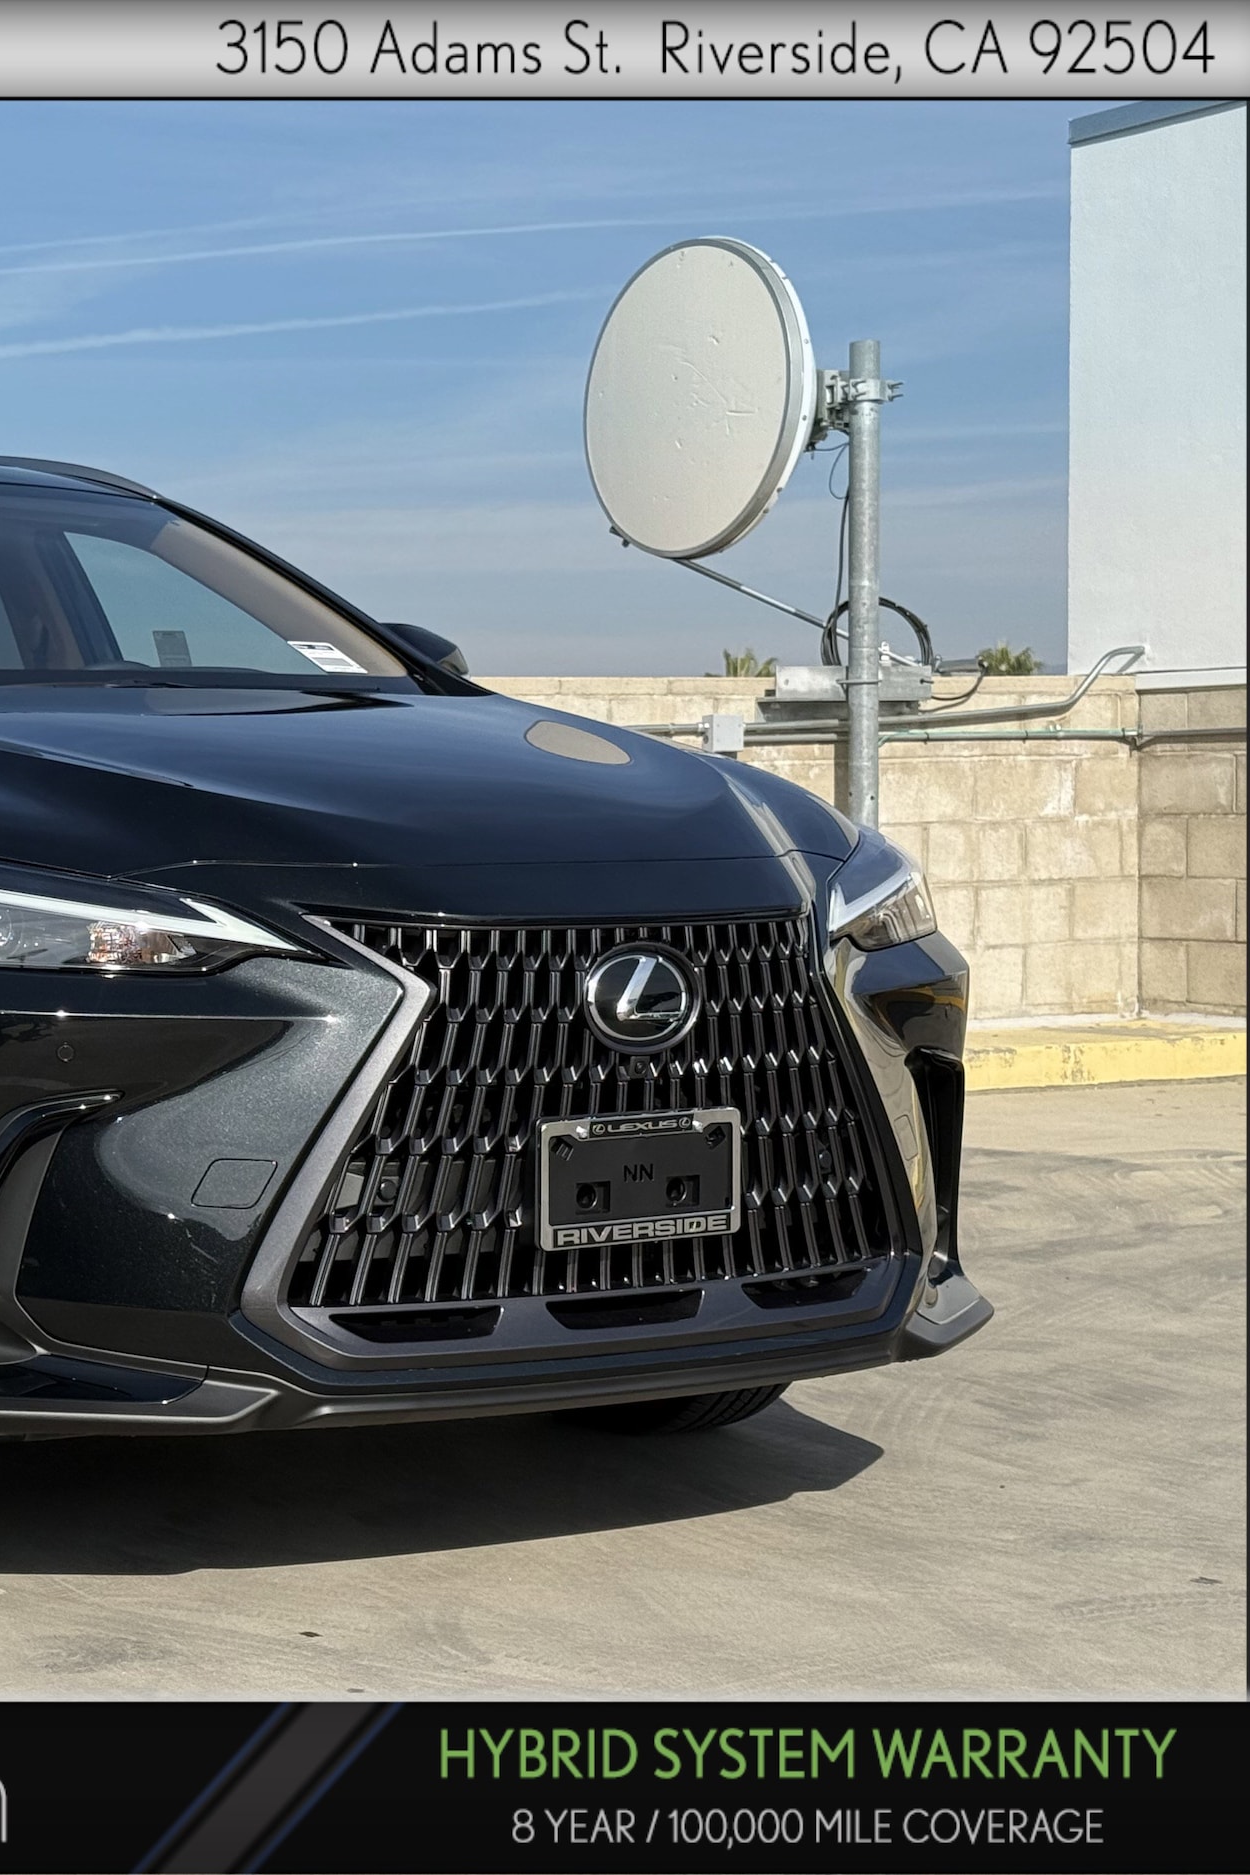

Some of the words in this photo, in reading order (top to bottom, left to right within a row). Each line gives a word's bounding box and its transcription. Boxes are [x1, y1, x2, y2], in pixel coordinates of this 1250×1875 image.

[607, 1120, 678, 1133] LEXUS
[623, 1163, 654, 1182] NN
[557, 1215, 727, 1246] RIVERSIDE
